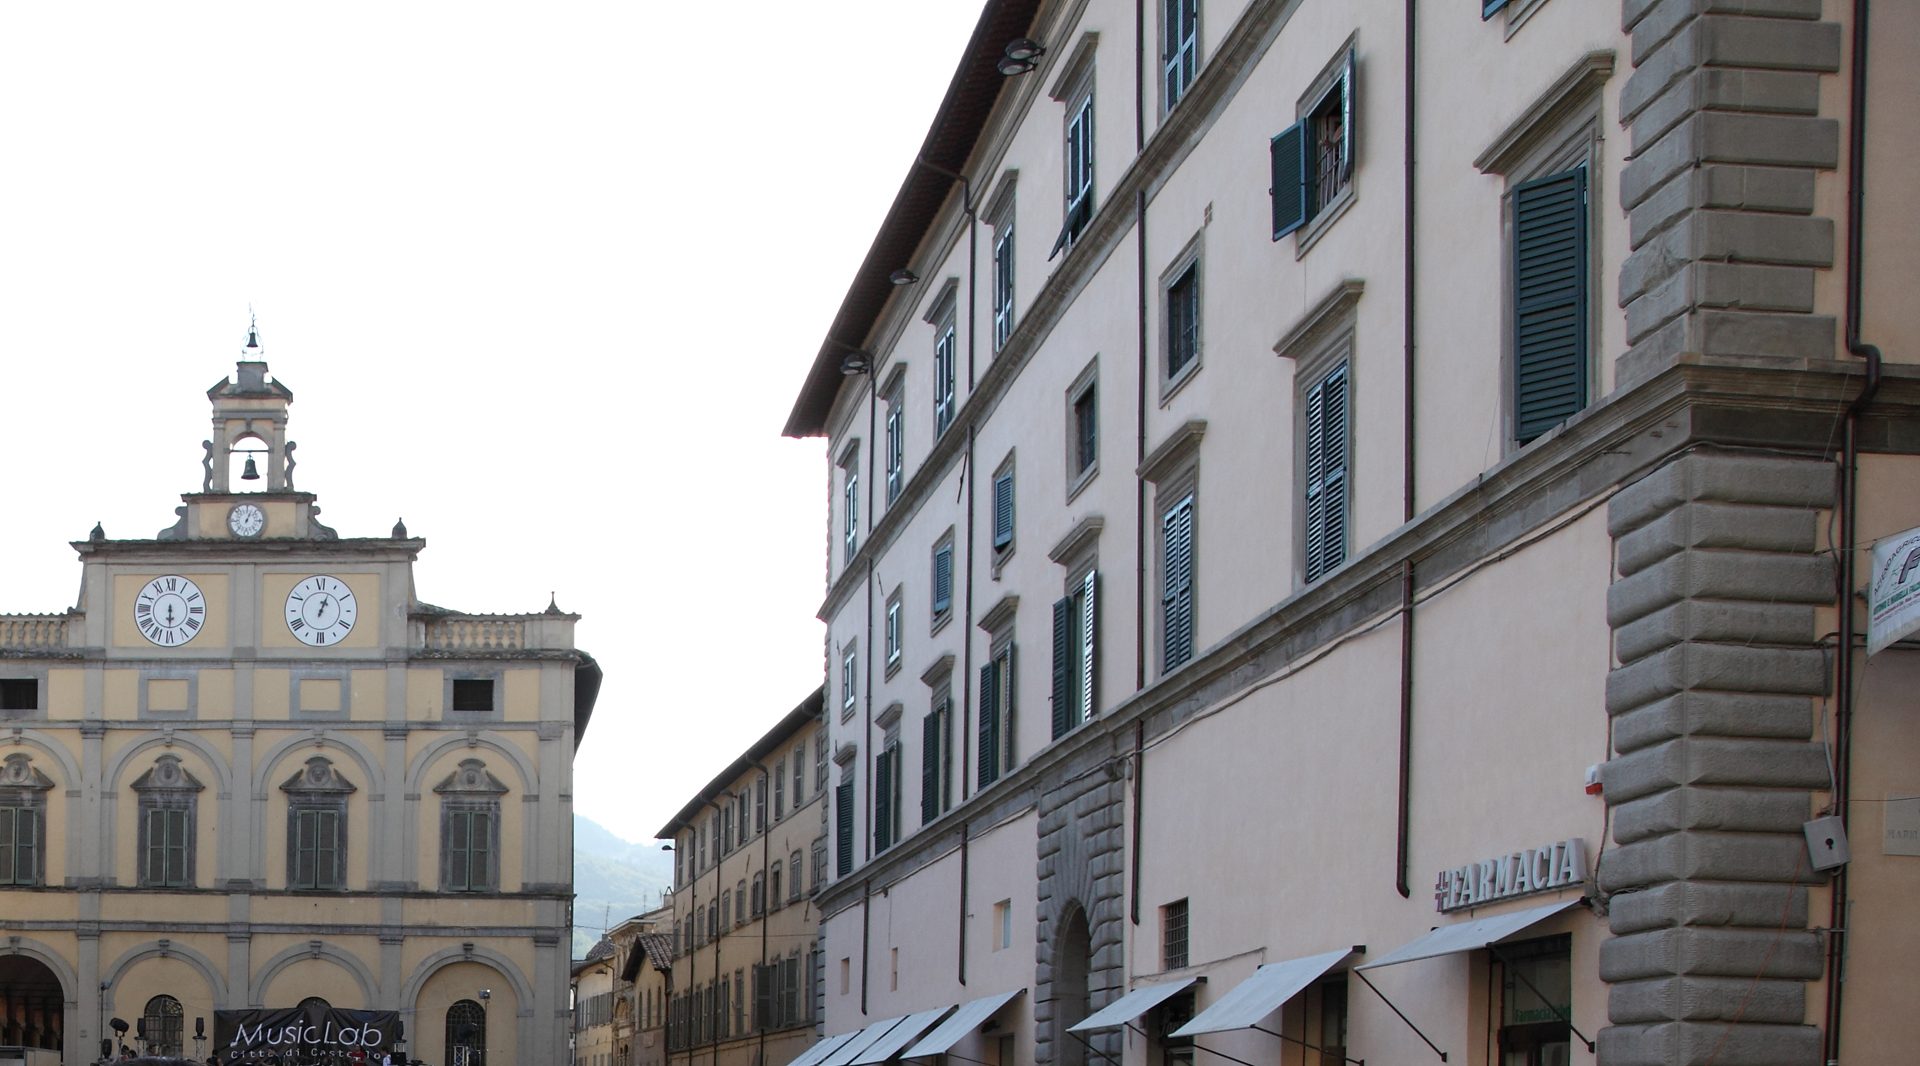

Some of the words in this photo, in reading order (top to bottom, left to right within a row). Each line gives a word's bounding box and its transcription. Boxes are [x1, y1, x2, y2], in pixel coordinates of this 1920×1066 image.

[1447, 838, 1587, 908] FARMACIA
[230, 1020, 382, 1047] MusicLab
[285, 1048, 300, 1057] di
[310, 1047, 381, 1060] Castelo
